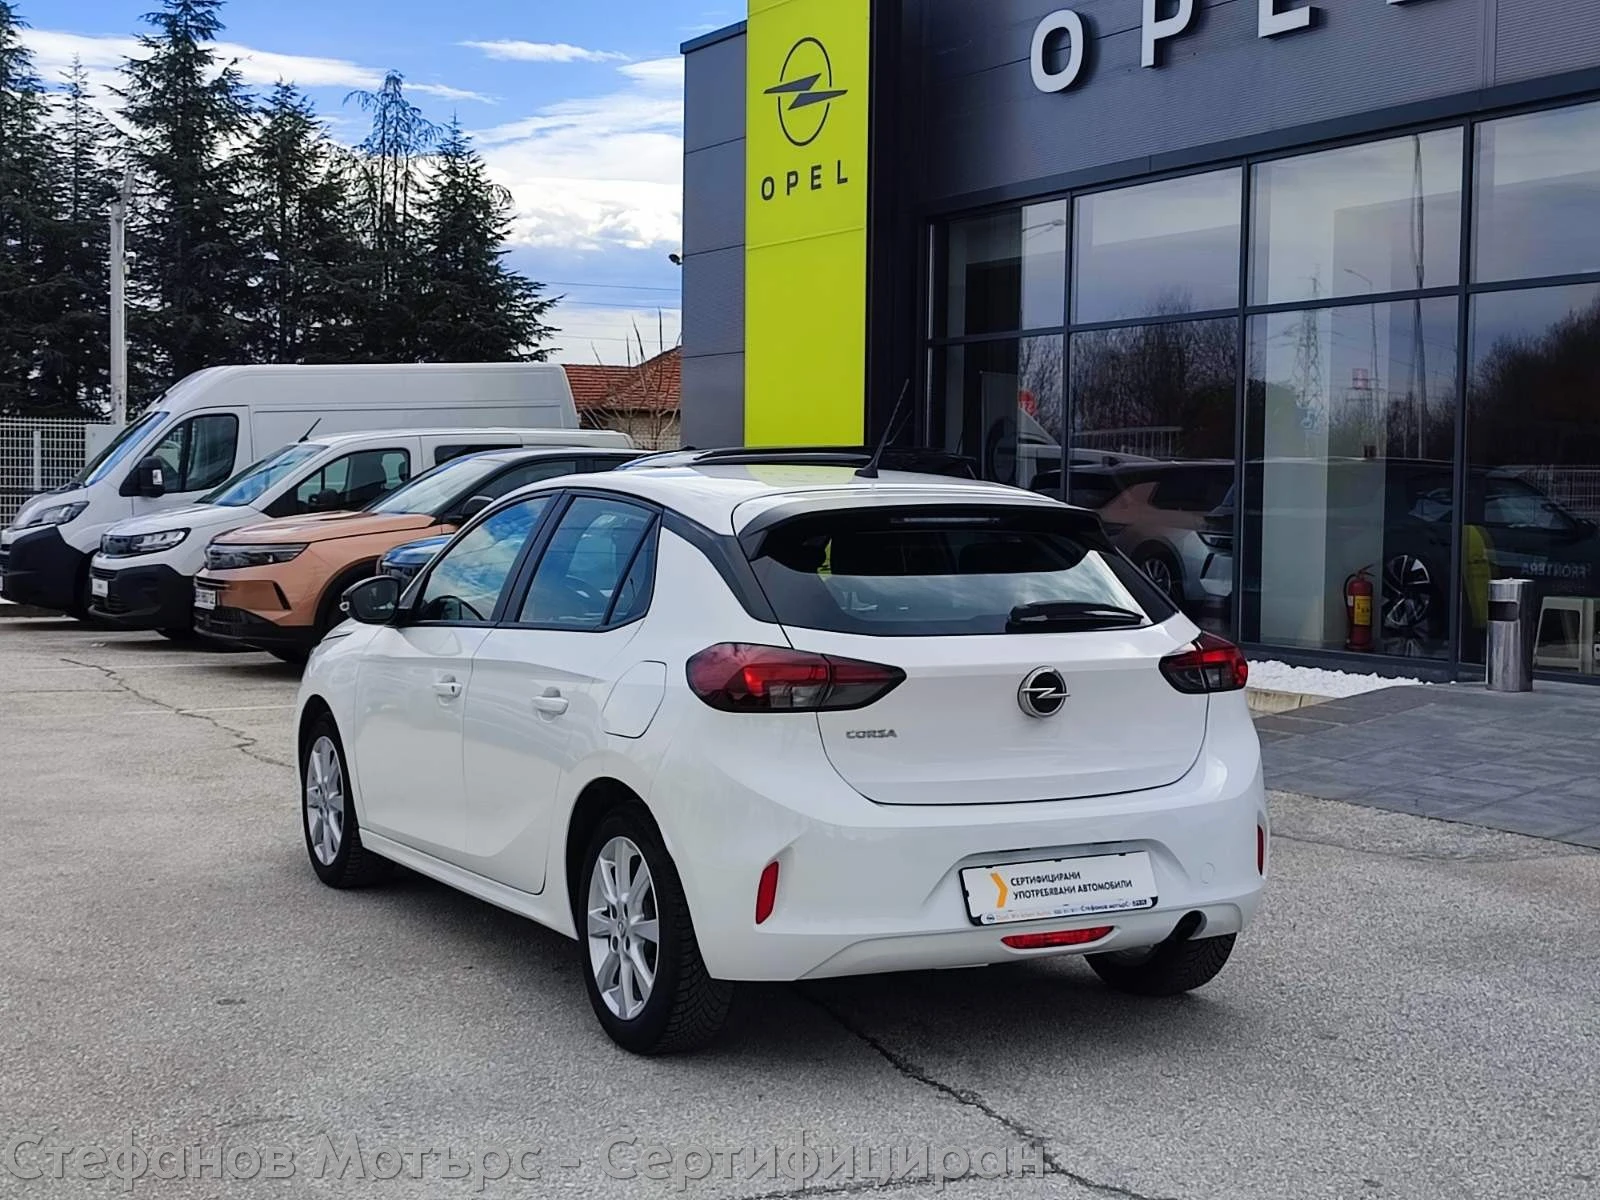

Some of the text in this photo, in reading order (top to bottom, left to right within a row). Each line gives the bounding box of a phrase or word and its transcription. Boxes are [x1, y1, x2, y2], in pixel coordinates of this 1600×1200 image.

[761, 160, 848, 201] OPEL
[846, 729, 897, 739] CORSA
[1010, 871, 1081, 887] СЕРТИФИЦИРАНИ
[1013, 879, 1133, 900] УПОТРЕБЯВАНИ АВТОМОБИЛИ
